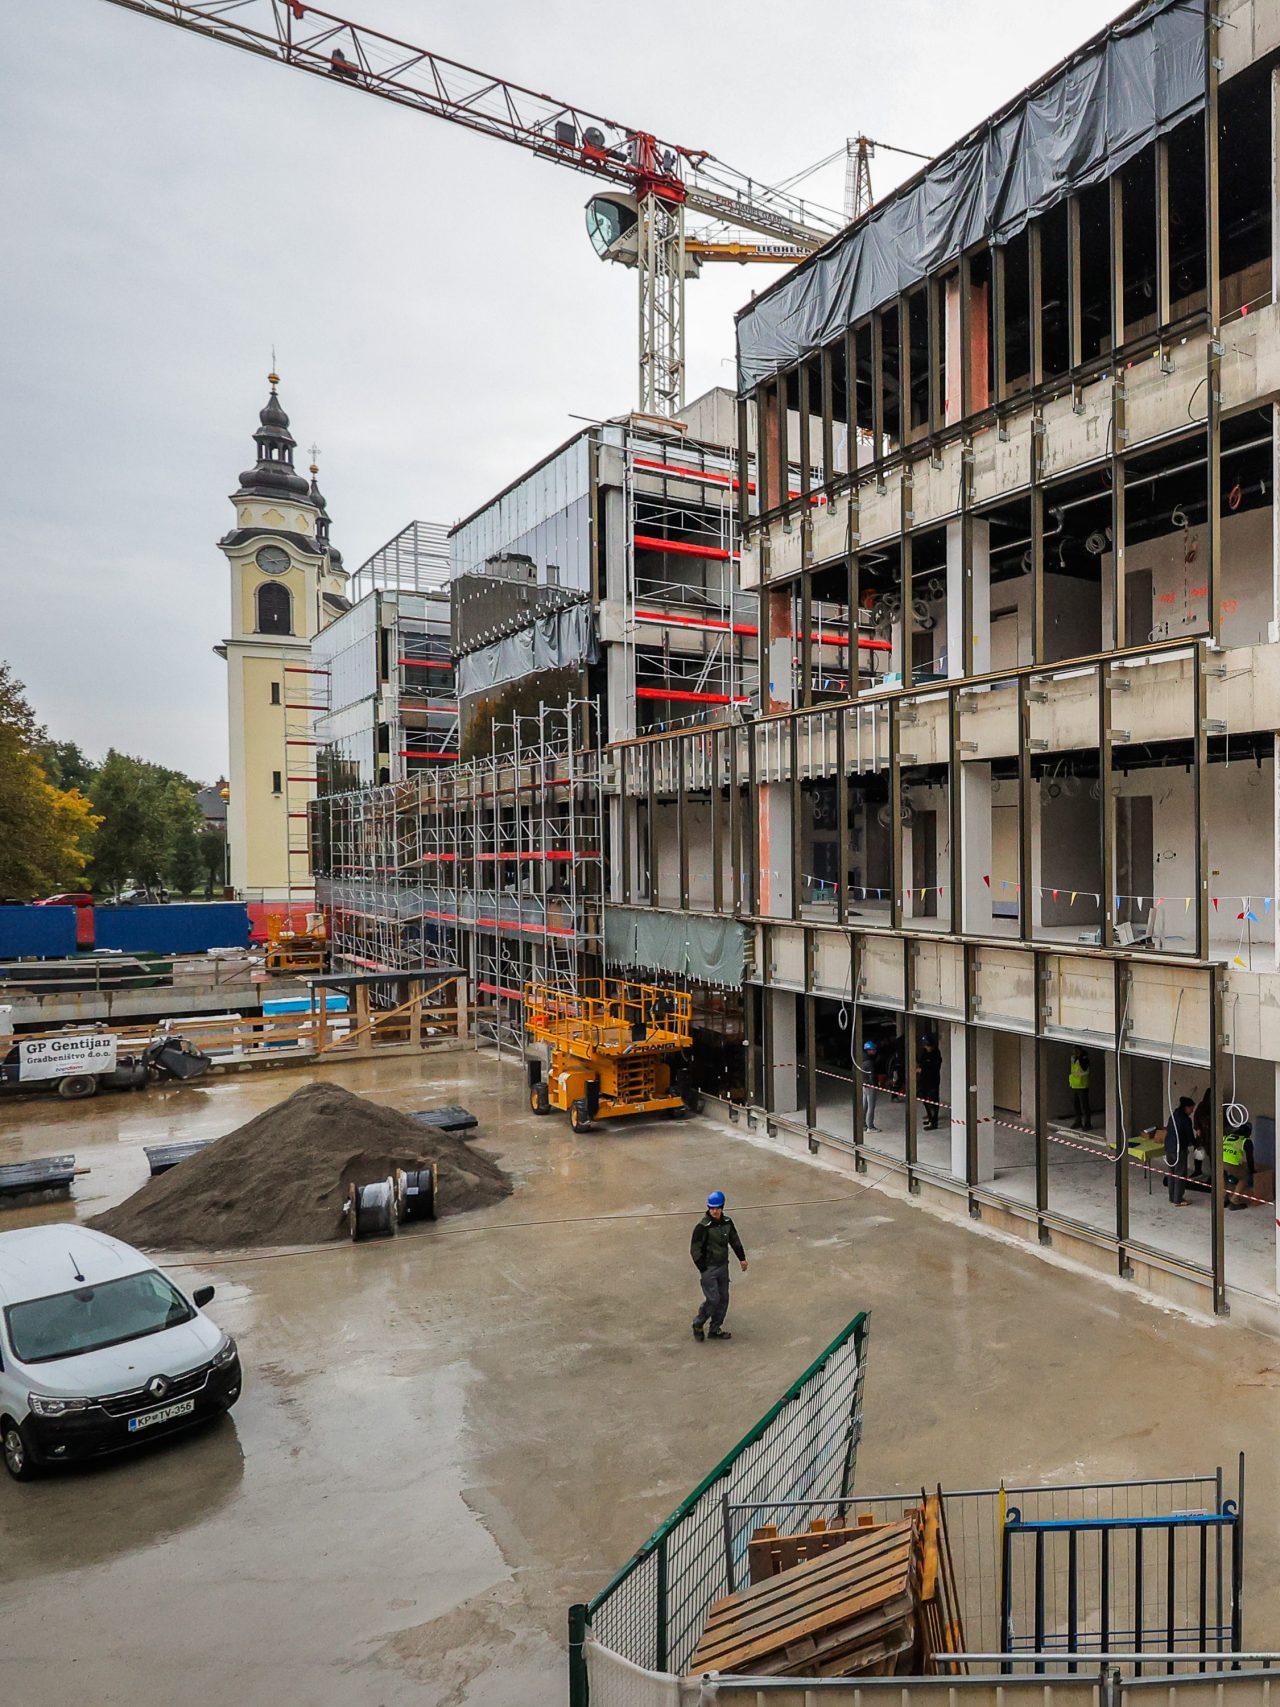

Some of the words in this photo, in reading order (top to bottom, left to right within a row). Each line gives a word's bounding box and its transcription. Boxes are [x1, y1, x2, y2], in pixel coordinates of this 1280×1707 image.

[621, 223, 639, 241] TERE
[26, 1042, 47, 1054] GP
[51, 1038, 111, 1052] Gentijan
[27, 1052, 86, 1064] Gradbeništvo
[88, 1050, 111, 1059] d.o.o.
[138, 1415, 151, 1426] KP
[159, 1402, 192, 1419] TV-356
